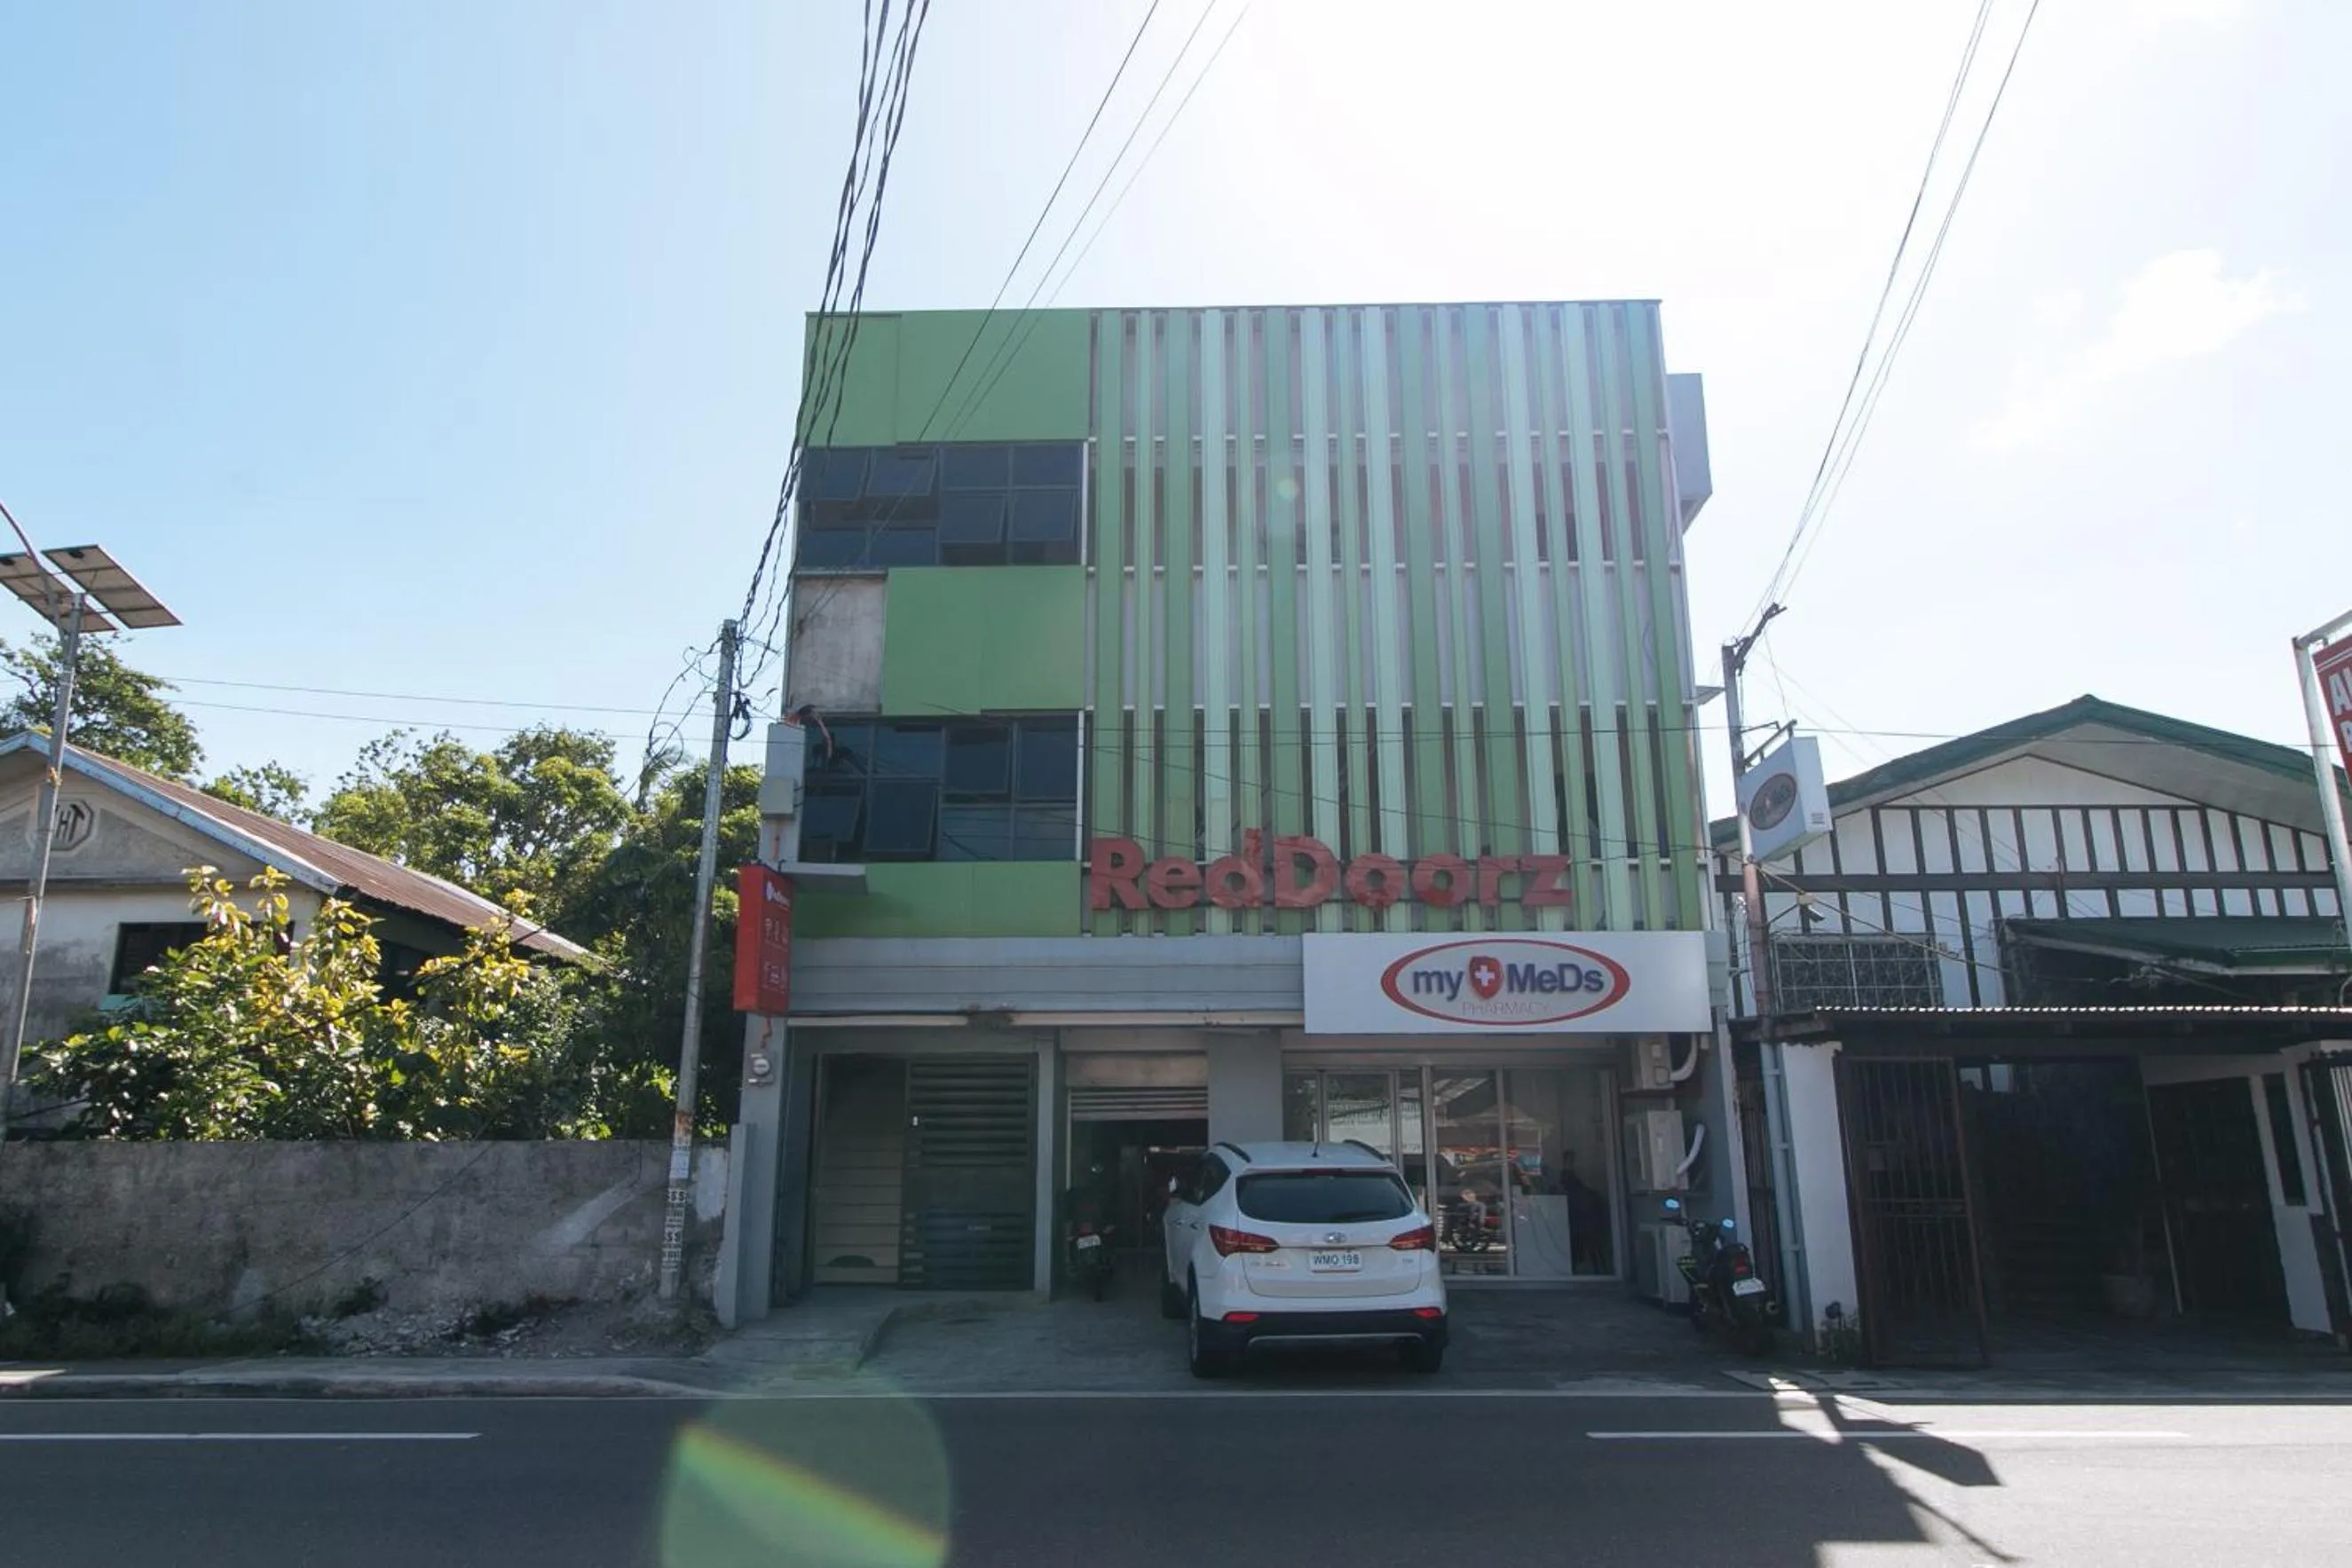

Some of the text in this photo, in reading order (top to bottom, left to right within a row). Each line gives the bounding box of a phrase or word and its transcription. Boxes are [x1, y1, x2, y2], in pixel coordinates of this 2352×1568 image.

[1091, 829, 1572, 910] RedDoorz
[1413, 964, 1604, 1002] my MeDs
[1463, 1001, 1551, 1015] PHARMACY
